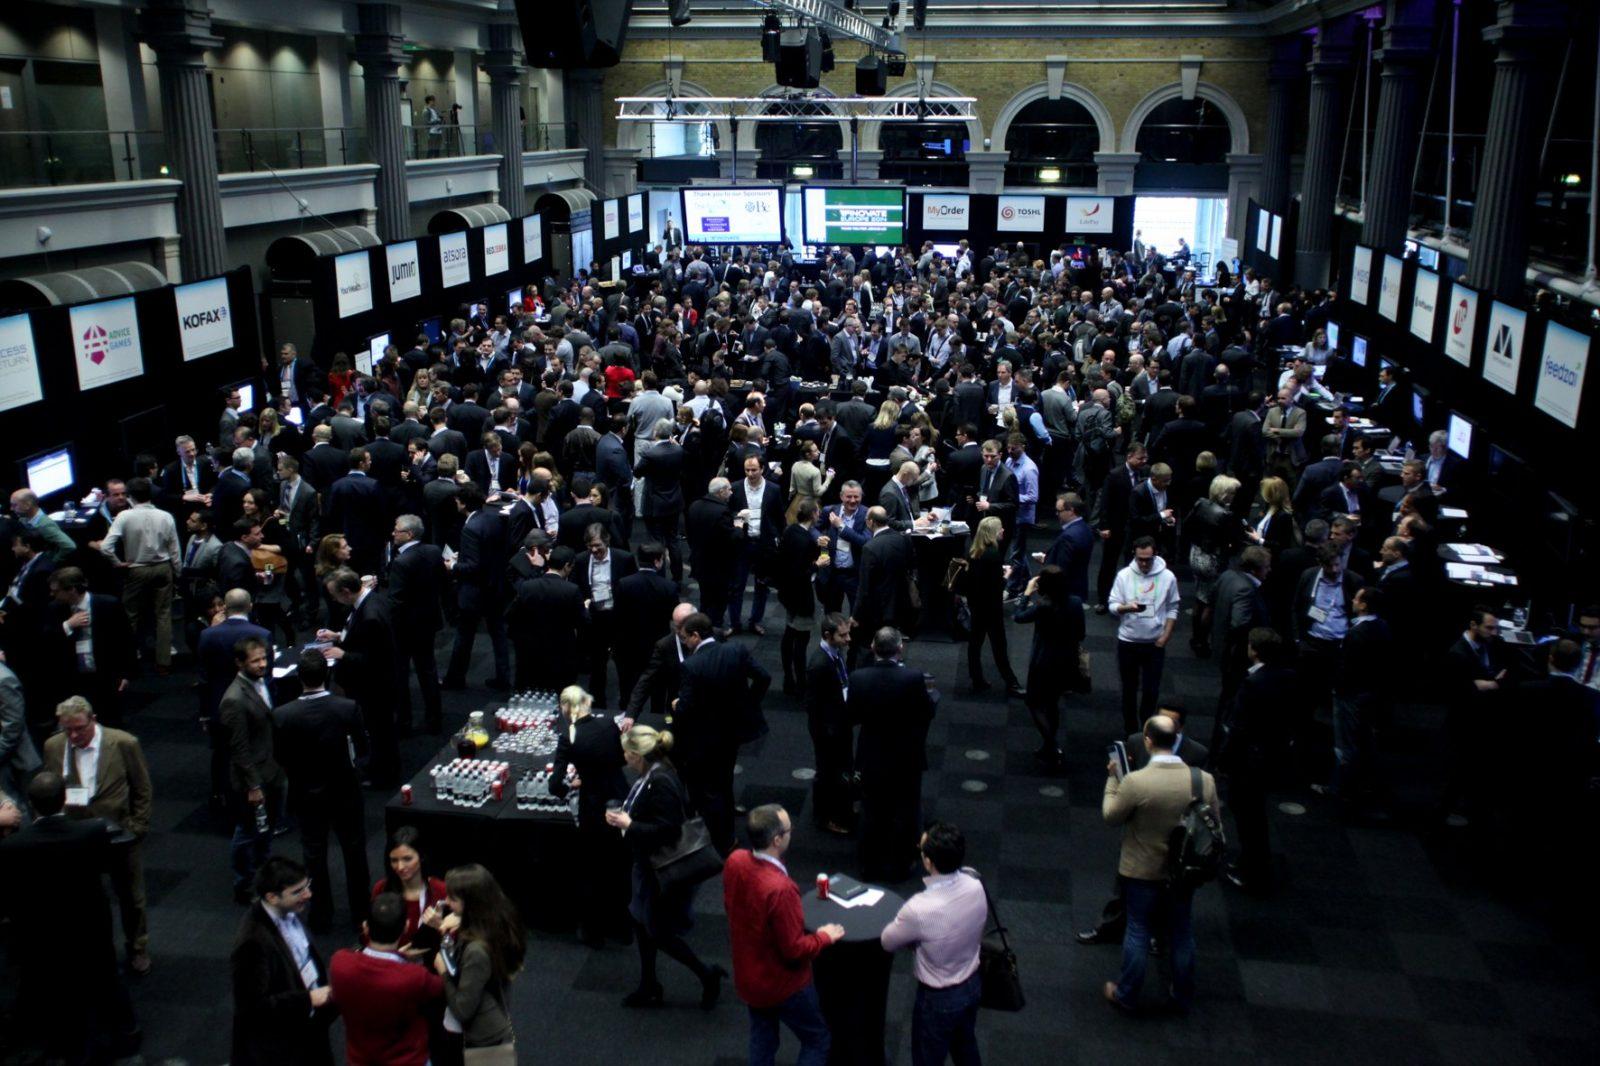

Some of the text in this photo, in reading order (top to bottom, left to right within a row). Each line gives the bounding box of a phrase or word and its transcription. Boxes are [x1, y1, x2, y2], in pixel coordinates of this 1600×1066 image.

[927, 205, 964, 216] MyOrder
[1018, 208, 1041, 216] TOSHL
[182, 307, 221, 330] KOFAX
[109, 327, 130, 339] ADVICE
[109, 337, 131, 350] GAMES
